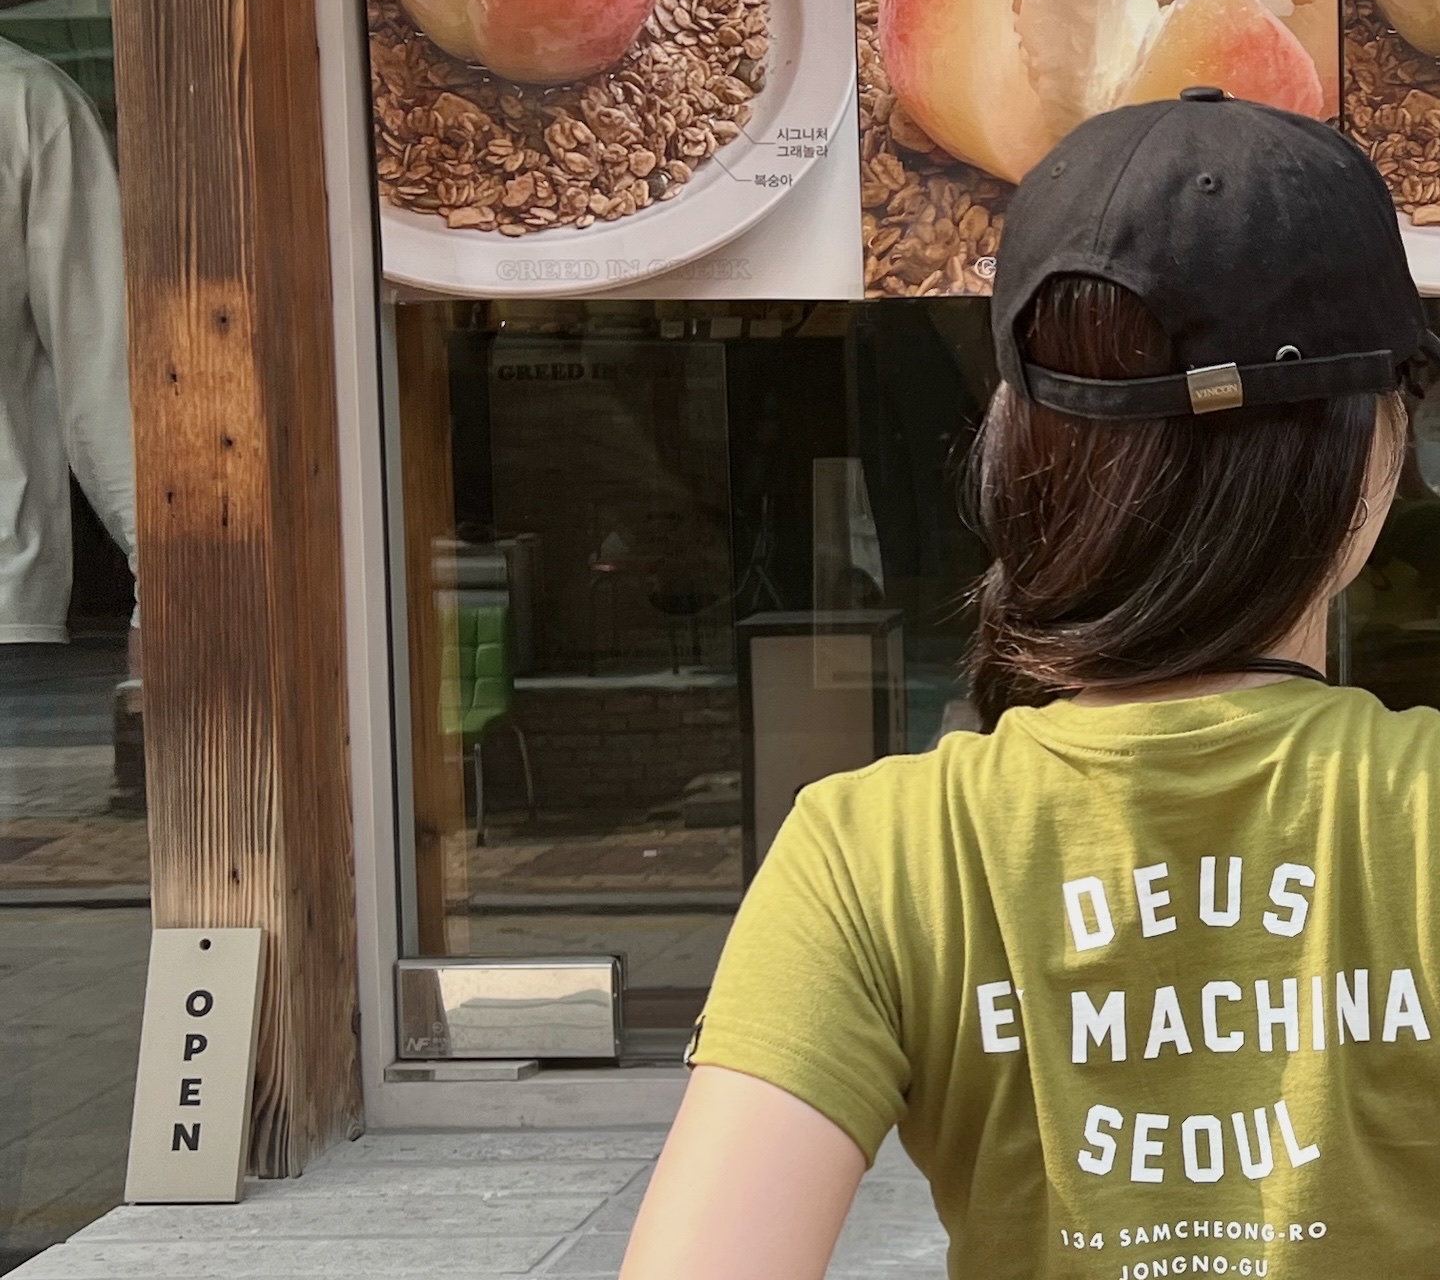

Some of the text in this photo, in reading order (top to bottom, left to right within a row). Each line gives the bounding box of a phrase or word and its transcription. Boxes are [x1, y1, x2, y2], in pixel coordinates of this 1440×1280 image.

[776, 127, 828, 141] 시그니처
[776, 145, 829, 158] 그래놀라
[754, 173, 793, 188] 복숭아
[495, 259, 600, 281] GREED
[606, 259, 641, 280] IN
[1063, 856, 1316, 952] DEUS
[976, 969, 1430, 1063] E MACHINA
[171, 989, 214, 1151] OPEN
[1077, 1100, 1320, 1183] SEOUL
[1061, 1220, 1327, 1250] 134 SAMCHEONG-RO
